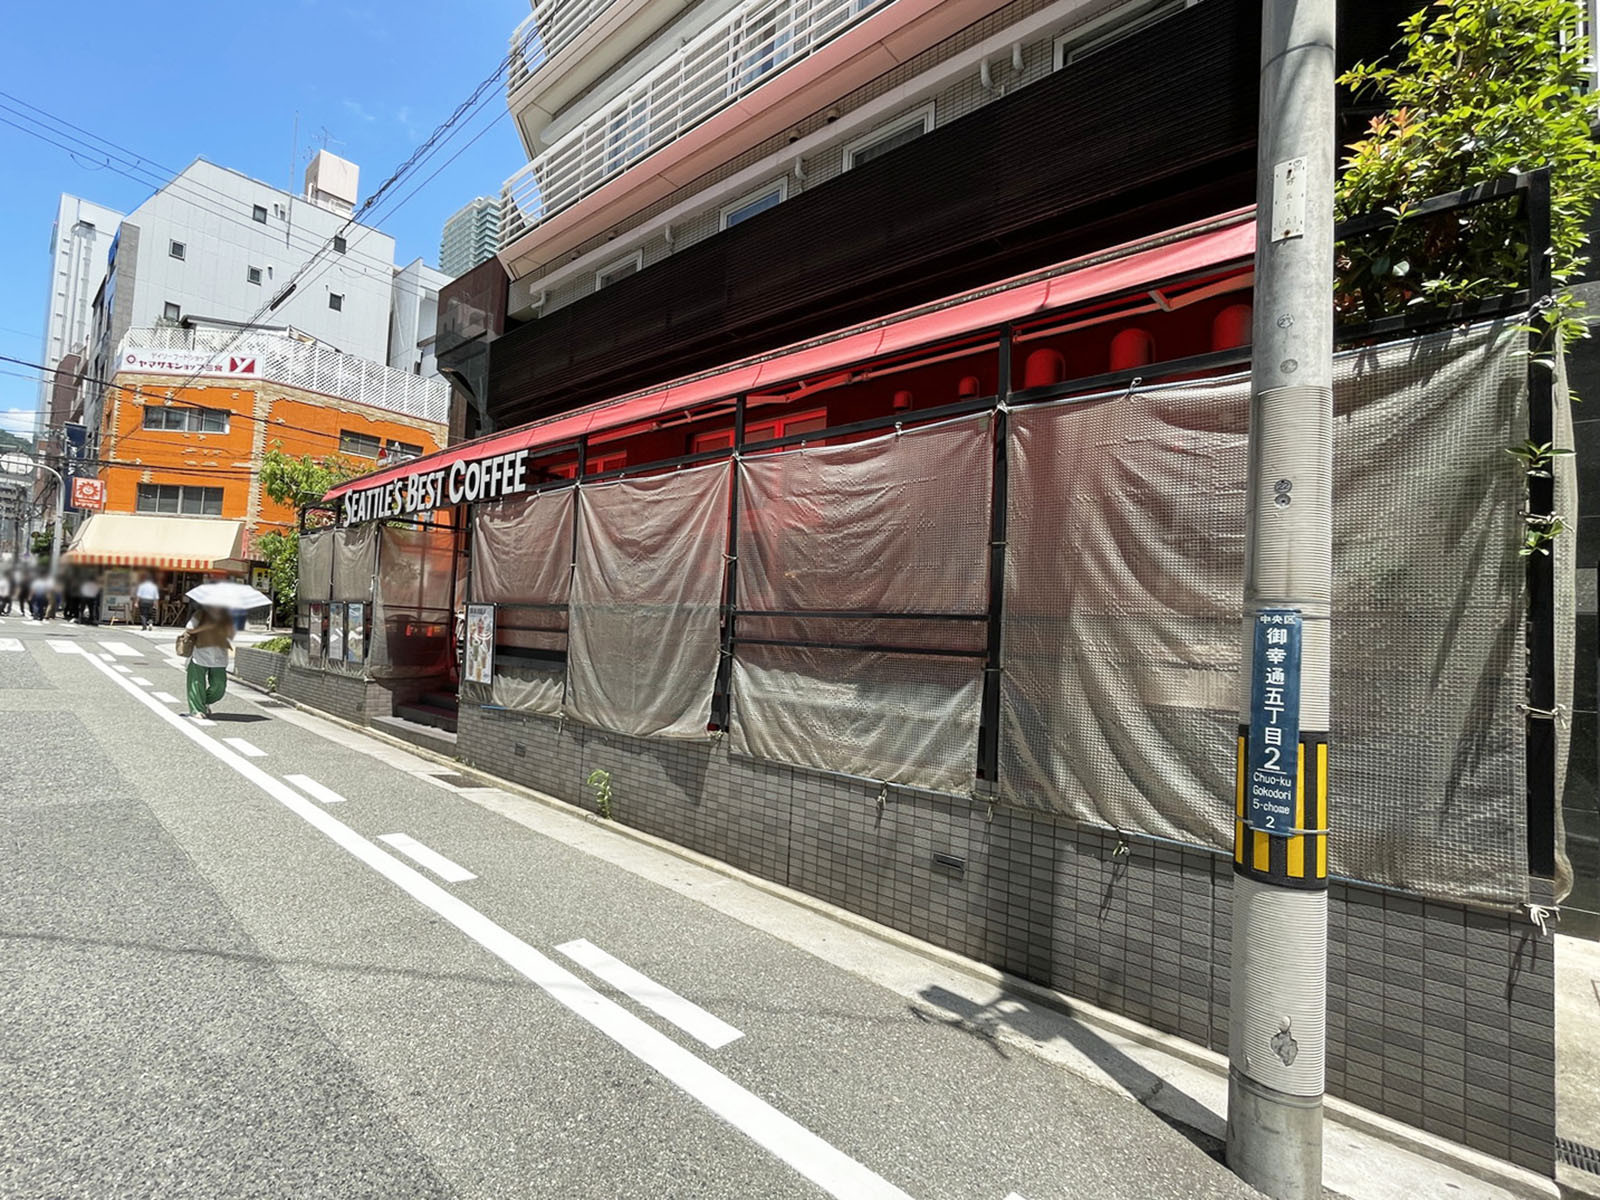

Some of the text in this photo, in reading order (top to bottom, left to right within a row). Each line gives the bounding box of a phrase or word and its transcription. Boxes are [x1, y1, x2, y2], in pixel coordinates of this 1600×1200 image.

[343, 449, 529, 527] SEATTLE'S BEST COFFEE
[1260, 614, 1296, 625] 中央区
[1253, 772, 1292, 787] Chuo-ku
[1253, 785, 1292, 800] Gokodori
[1253, 798, 1290, 815] 5-chome
[1265, 815, 1276, 829] 2
